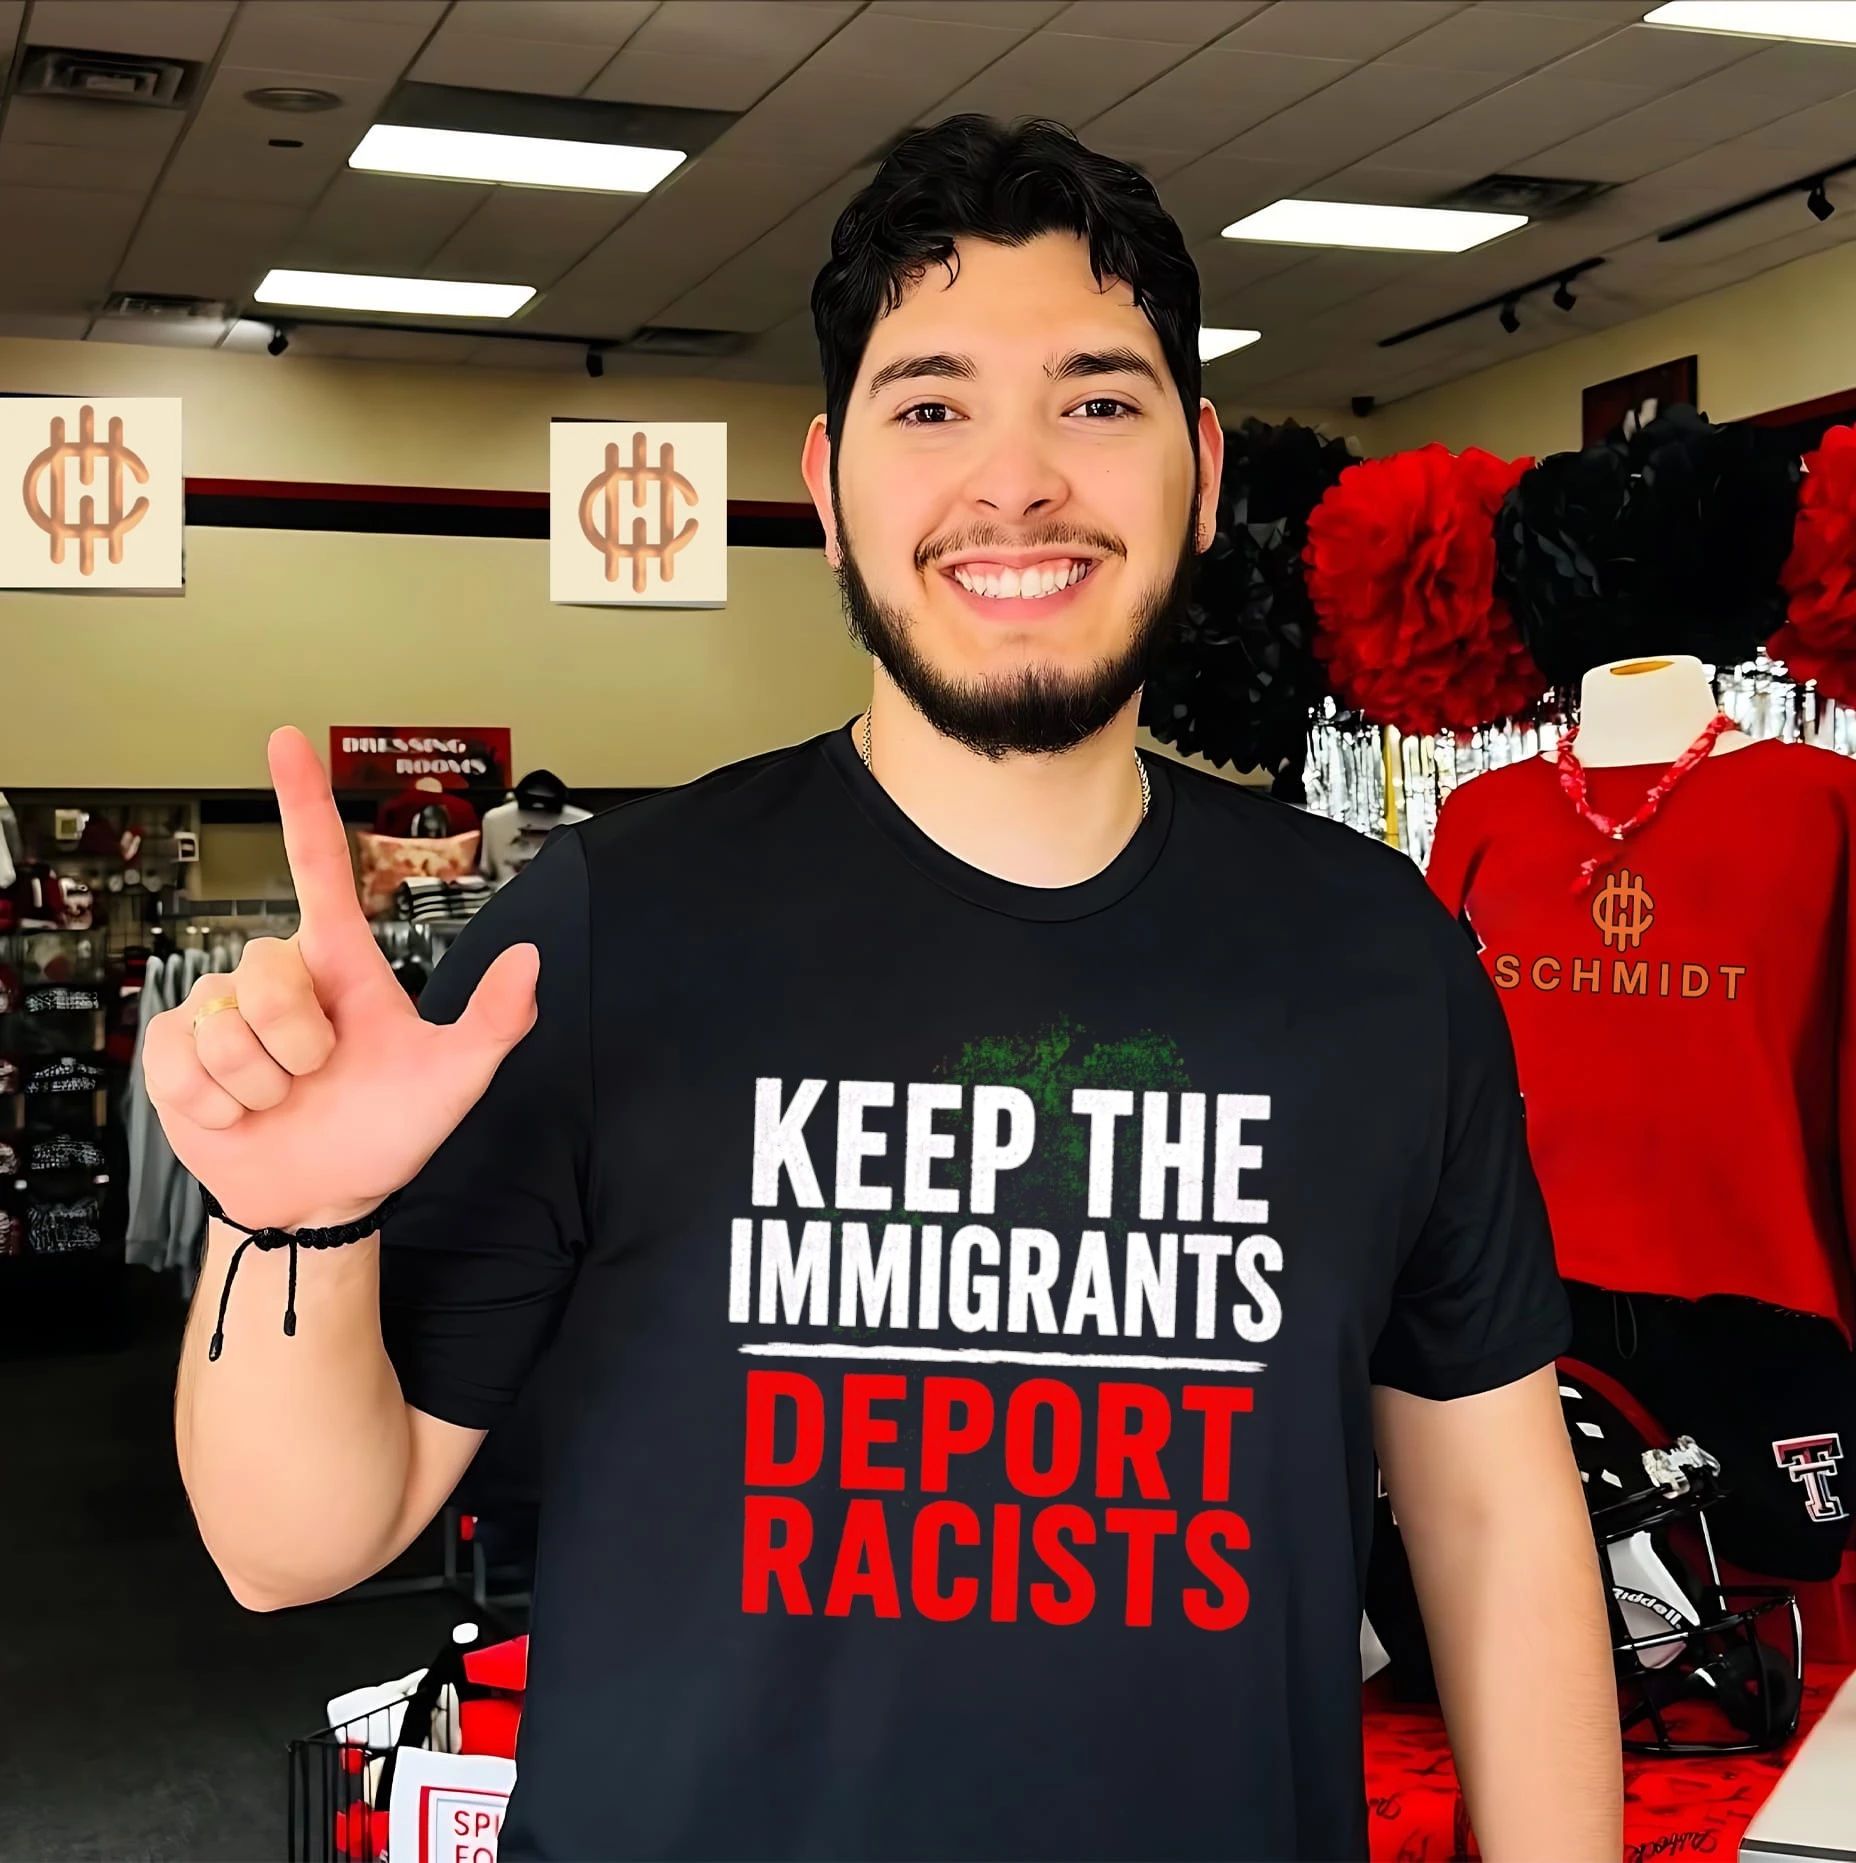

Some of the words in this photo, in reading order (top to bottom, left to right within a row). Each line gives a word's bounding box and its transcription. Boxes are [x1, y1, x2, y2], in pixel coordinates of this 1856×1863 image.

[396, 758, 487, 775] ROOMS
[1494, 954, 1747, 1000] SCHMIDT
[752, 1077, 1036, 1214] KEEP
[1072, 1088, 1271, 1223] THE
[728, 1217, 1284, 1343] IMMIGRANTS
[744, 1369, 1254, 1502] DEPORT
[741, 1494, 1252, 1632] RACISTS
